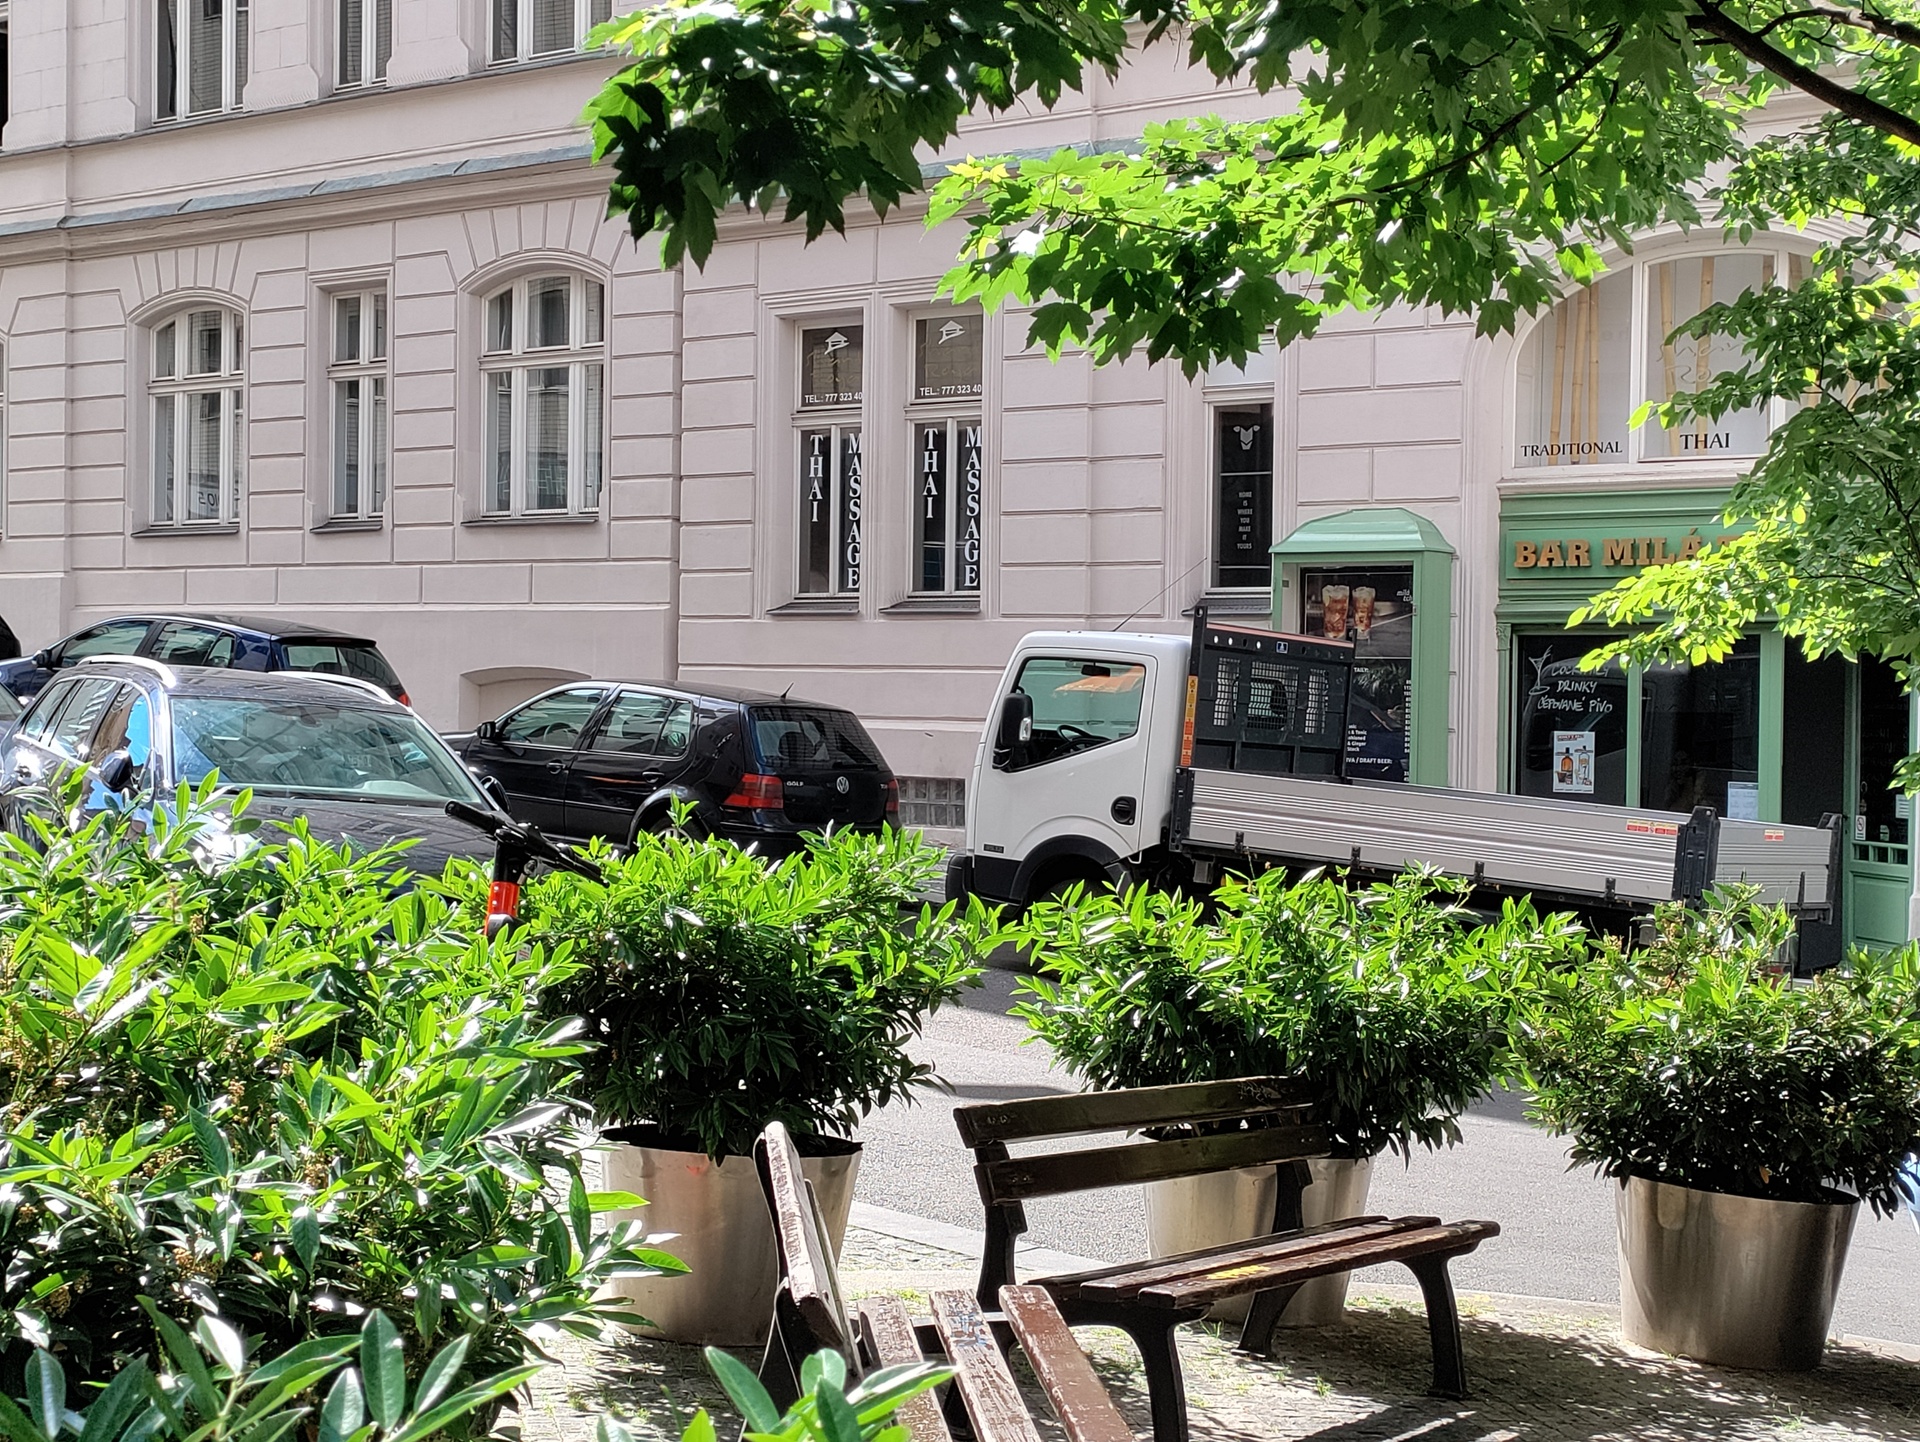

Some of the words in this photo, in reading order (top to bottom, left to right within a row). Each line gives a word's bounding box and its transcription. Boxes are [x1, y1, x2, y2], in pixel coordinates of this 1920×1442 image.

[804, 394, 824, 404] TEL.:
[824, 393, 838, 402] 777
[839, 393, 853, 401] 323
[920, 387, 940, 397] TEL.:
[941, 386, 956, 395] 777
[957, 385, 970, 394] 323
[1521, 441, 1623, 457] TRADITIONAL
[1679, 432, 1731, 450] THAI
[808, 434, 824, 522] THAI
[922, 428, 939, 519] THAI
[846, 433, 863, 589] MASSAGE
[964, 426, 983, 587] MASSAGE
[1514, 538, 1592, 569] BAR
[1556, 680, 1598, 693] DRINKY
[1537, 695, 1586, 711] ČEPOVANÉ
